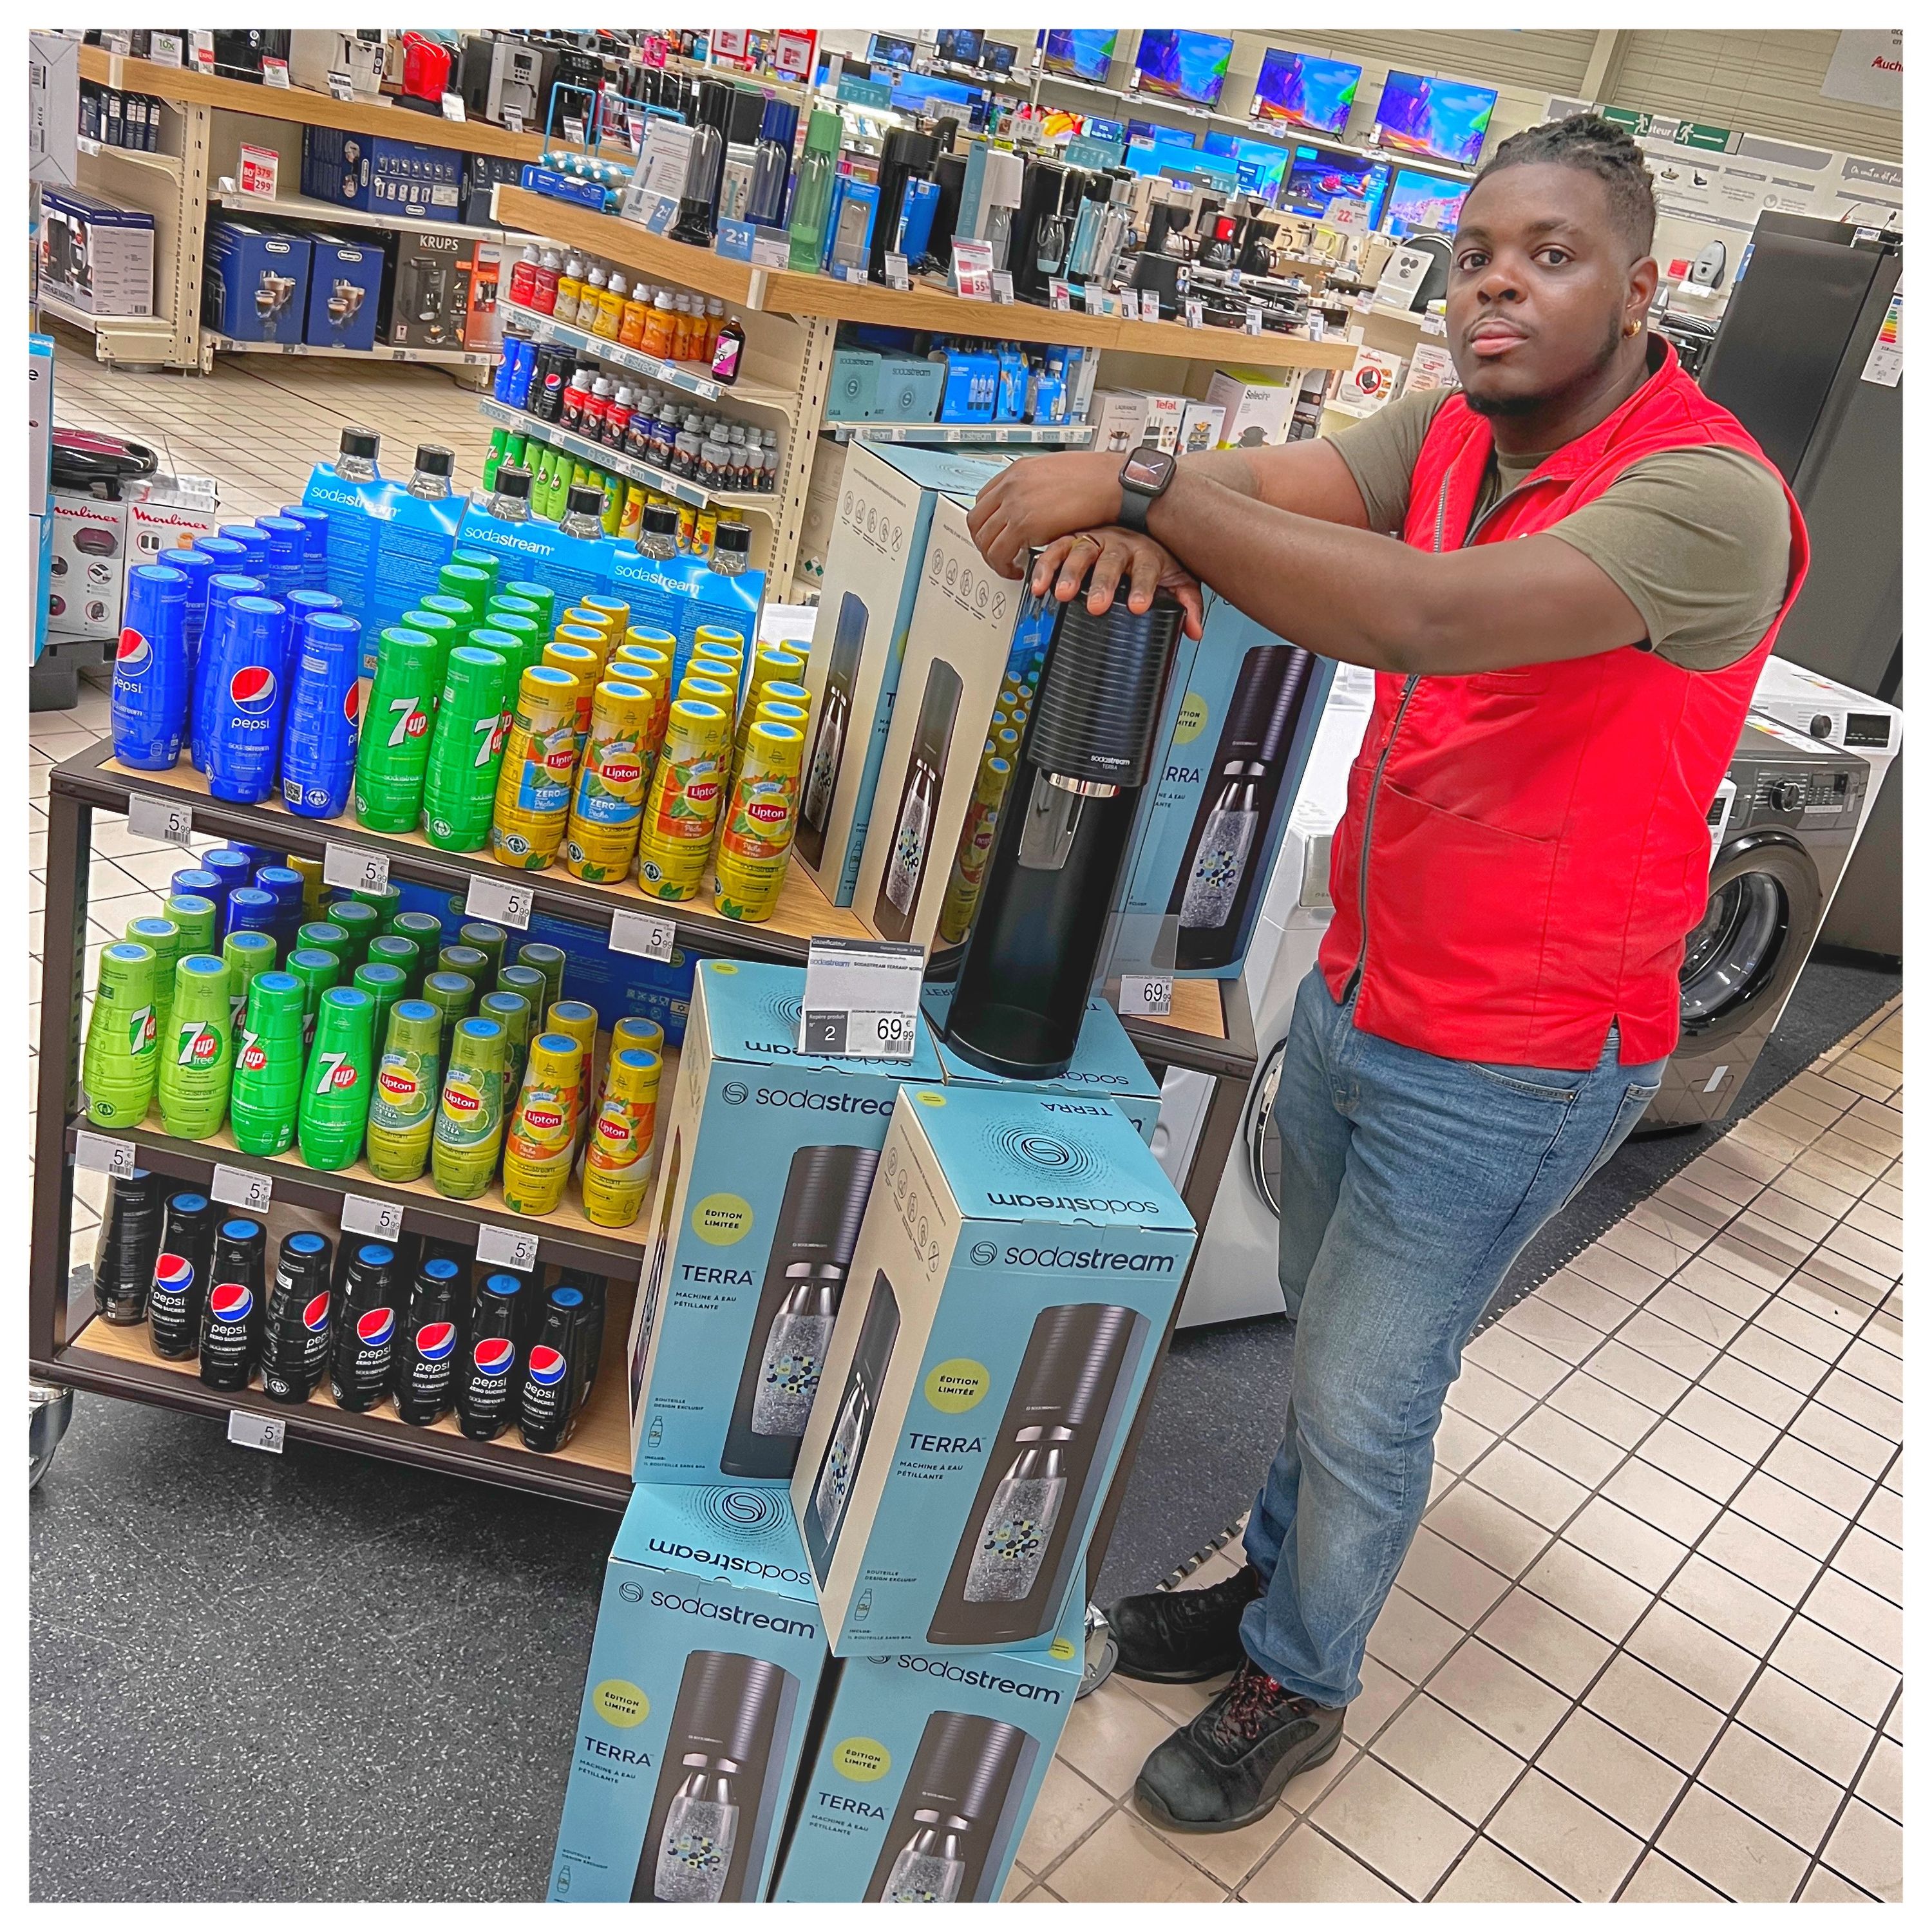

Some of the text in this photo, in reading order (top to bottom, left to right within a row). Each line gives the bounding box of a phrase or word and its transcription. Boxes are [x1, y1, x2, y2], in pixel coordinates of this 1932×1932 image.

[1871, 56, 1903, 72] Auch
[255, 180, 270, 191] 299
[420, 236, 459, 251] KRUPS
[1155, 399, 1177, 411] Tefal
[310, 488, 397, 516] sodastream
[54, 507, 119, 524] oulinex
[133, 507, 209, 530] Moulinex
[464, 526, 551, 556] sodastream
[614, 564, 701, 593] sodastream
[114, 677, 144, 694] pepsi
[1180, 710, 1200, 719] ITION
[231, 717, 270, 732] pepsi
[550, 755, 573, 767] Lipto
[1090, 755, 1131, 766] sodastream
[605, 766, 638, 780] Lipton
[1164, 766, 1200, 784] RRA
[535, 789, 560, 799] ZERO
[690, 784, 718, 799] Lipton
[590, 798, 616, 810] ZERO
[751, 805, 785, 819] Lipton
[169, 813, 191, 835] 5 99
[365, 862, 388, 884] 5 99
[507, 895, 529, 917] 5 99
[651, 928, 673, 949] 5 99
[1144, 982, 1171, 1003] 69 99
[824, 1025, 837, 1041] 2
[877, 1018, 914, 1041] 69 99
[178, 1020, 217, 1066] 7up
[236, 1028, 265, 1070] 7up
[193, 1054, 215, 1066] free
[316, 1052, 356, 1095] 7up
[379, 1075, 413, 1092] Lipton
[445, 1092, 477, 1109] Lipton
[755, 1088, 895, 1117] sodastrea
[1040, 1101, 1113, 1117] TERRA
[527, 1111, 560, 1126] Lipton
[598, 1122, 626, 1139] Lipton
[113, 1149, 124, 1166] 5
[249, 1183, 260, 1199] 5
[987, 1192, 1160, 1215] sodastream
[379, 1211, 400, 1229] 5 99
[705, 1209, 743, 1219] ÉDITION
[705, 1219, 740, 1229] LIMITÉE
[515, 1242, 535, 1262] 5 99
[1004, 1245, 1175, 1274] sodastream
[681, 1264, 753, 1285] TERRA
[153, 1291, 185, 1307] pepsi
[675, 1291, 711, 1301] MACHINE
[674, 1300, 719, 1311] PÉTILLANTE
[211, 1323, 246, 1336] pepsi
[357, 1344, 391, 1360] pepsi
[415, 1361, 450, 1373] pepsi
[471, 1376, 507, 1388] pepsi
[940, 1375, 979, 1386] ÉDITION
[524, 1381, 556, 1399] pepsi
[938, 1386, 975, 1396] LIMITÉE
[263, 1425, 274, 1441] 5
[909, 1433, 983, 1454] TERRA
[899, 1461, 938, 1471] MACHINE
[896, 1470, 943, 1481] PÉTILLANTE
[648, 1537, 811, 1585] sodastream
[650, 1590, 816, 1640] sodastream
[896, 1654, 1062, 1705] sodastream
[604, 1690, 640, 1707] ÉDITION
[604, 1701, 637, 1716] LIMITÉE
[584, 1736, 651, 1768] TERRA
[845, 1748, 882, 1763] ÉDITION
[580, 1759, 612, 1774] MACHINE
[844, 1757, 878, 1770] LIMITÉE
[578, 1766, 619, 1785] PÉTILLANTE
[818, 1792, 886, 1821] TERRA
[809, 1821, 852, 1836] PÉTILLANTE
[811, 1813, 846, 1826] MACHINE
[854, 1823, 869, 1833] EAU
